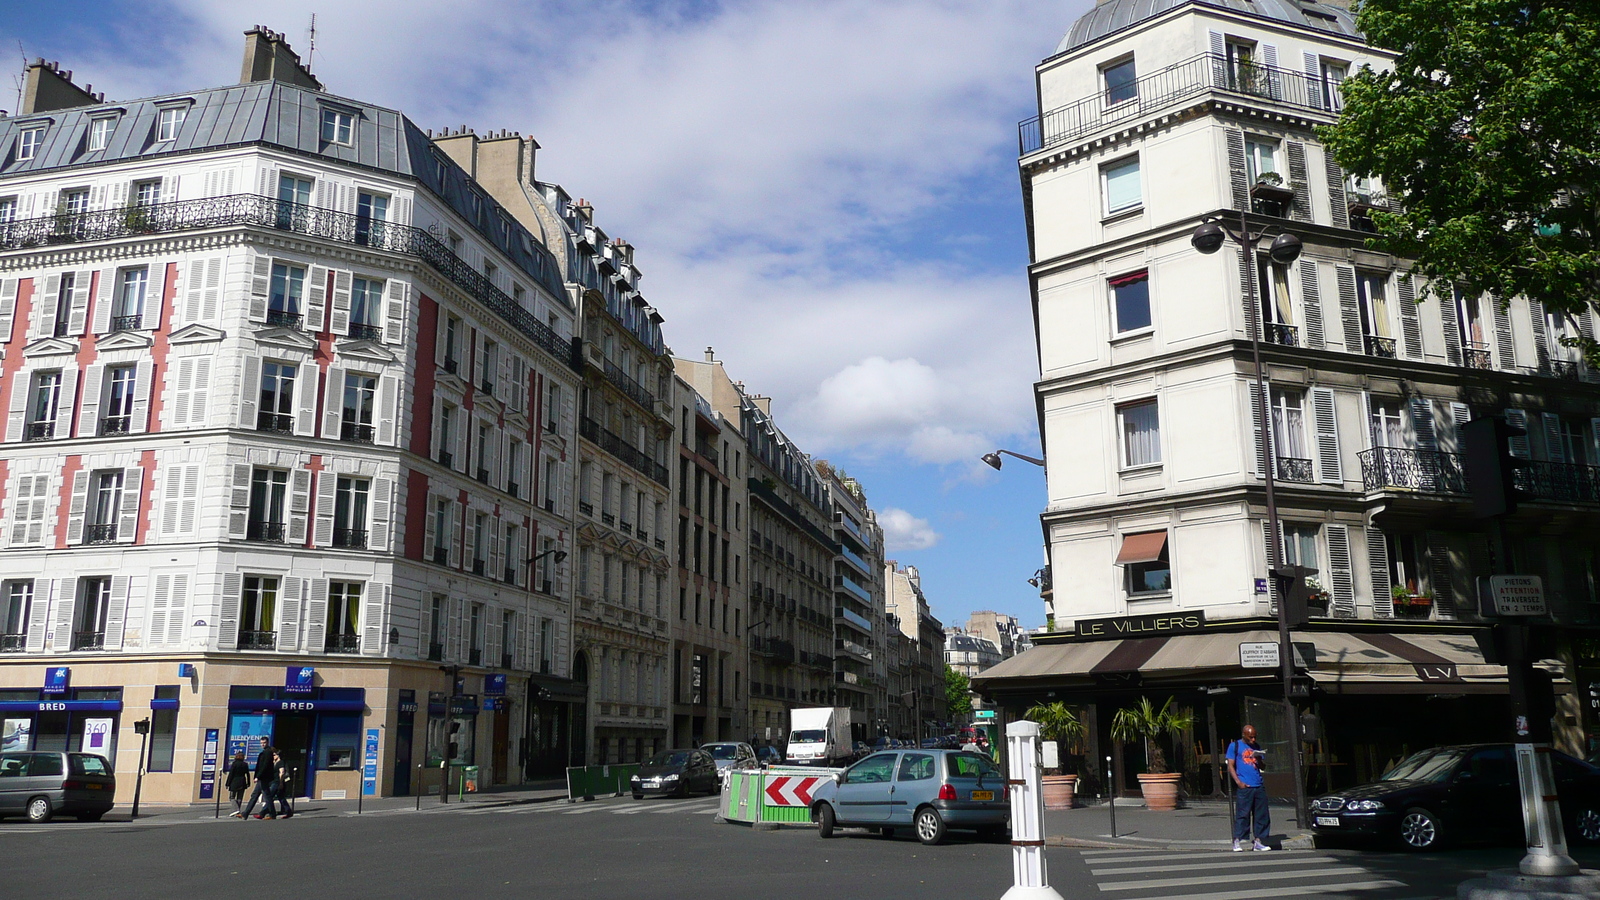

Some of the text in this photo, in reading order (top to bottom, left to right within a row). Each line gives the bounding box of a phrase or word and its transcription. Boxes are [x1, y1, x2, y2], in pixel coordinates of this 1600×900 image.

[1504, 578, 1531, 586] PIETONS
[1080, 616, 1200, 636] LE VILLIERS
[1423, 667, 1451, 679] LV
[39, 703, 66, 711] BRED
[281, 702, 314, 710] BRED
[401, 704, 418, 712] BRED
[86, 722, 108, 736] 360
